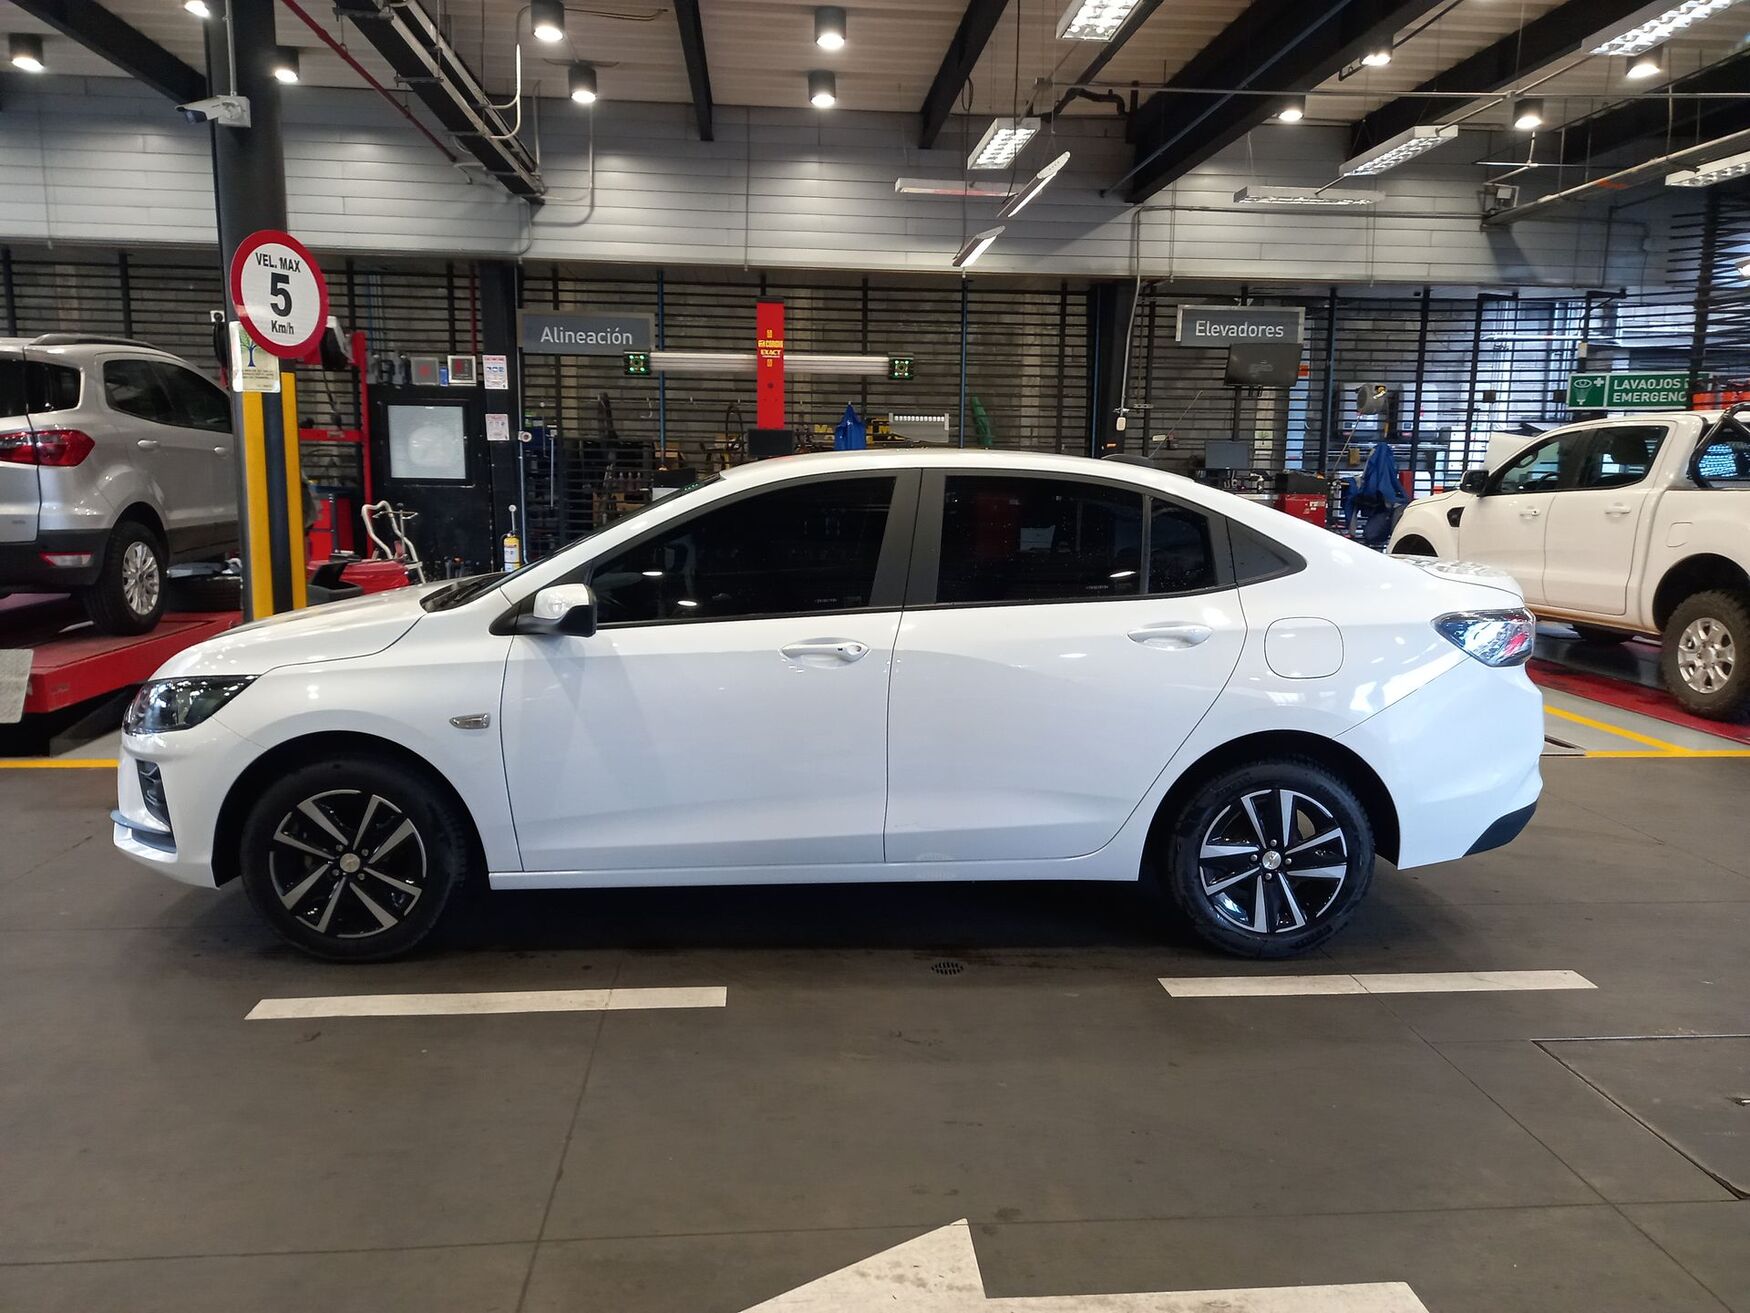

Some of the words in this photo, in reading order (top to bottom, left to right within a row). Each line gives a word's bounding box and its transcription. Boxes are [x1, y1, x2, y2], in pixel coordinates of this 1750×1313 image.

[255, 252, 278, 268] VEL.
[279, 257, 301, 273] MAX
[270, 272, 293, 317] 5
[271, 320, 295, 335] Km/h
[540, 326, 633, 345] Alineación
[1195, 320, 1284, 337] Elevadores
[1613, 378, 1681, 390] LAVAOJOS
[1612, 391, 1688, 403] EMERGENC
